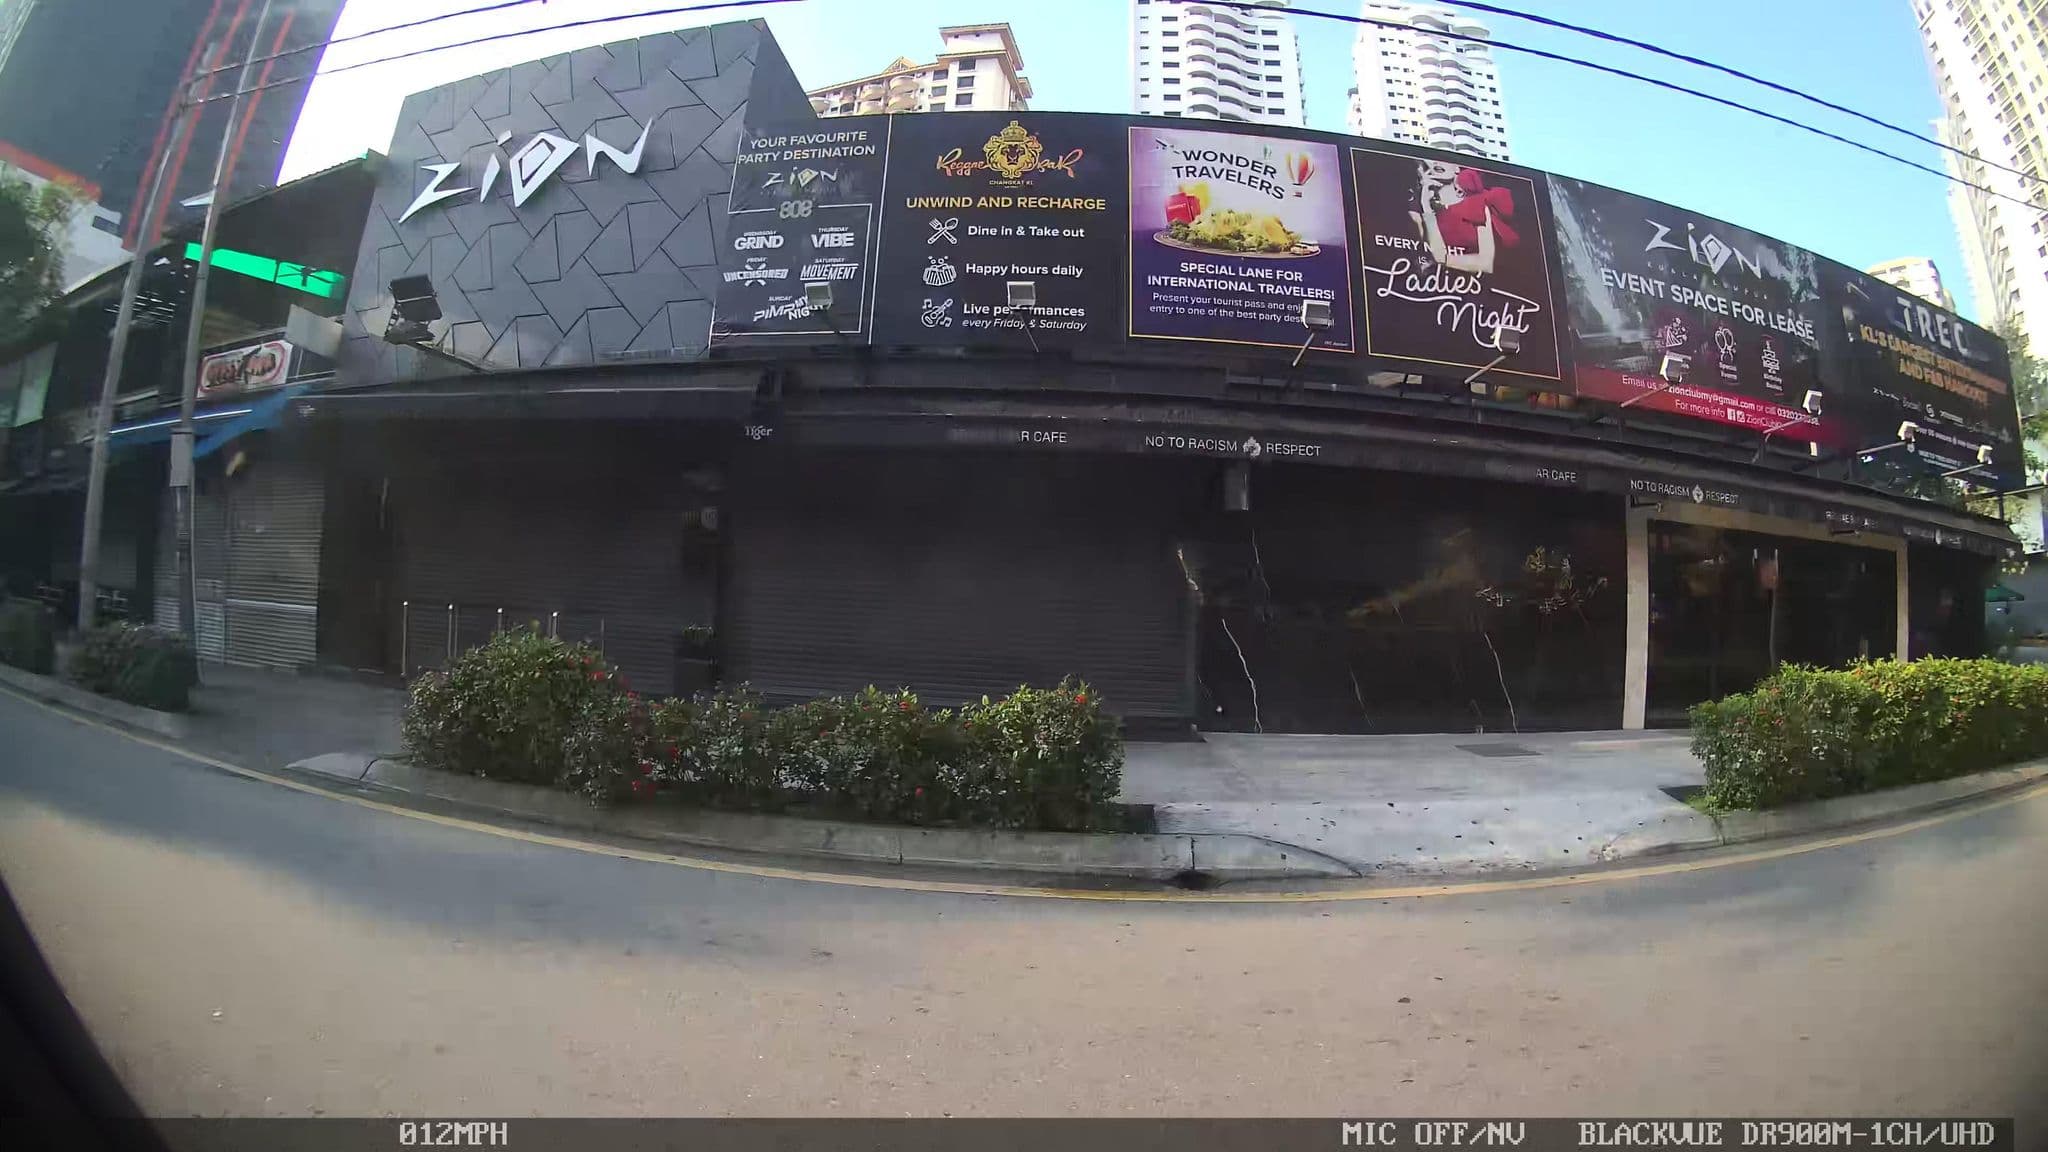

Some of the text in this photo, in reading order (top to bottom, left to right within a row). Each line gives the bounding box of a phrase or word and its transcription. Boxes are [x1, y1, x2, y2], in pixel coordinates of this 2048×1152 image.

[750, 131, 868, 150] YOUR FAVOURITE
[738, 145, 876, 164] PARTY DESTINATION
[1182, 150, 1278, 180] WONDER
[1171, 165, 1286, 200] TRAVELERS
[779, 200, 813, 219] 808
[906, 197, 1106, 210] UNWIND AND RECHARGE
[811, 232, 855, 248] VIBE
[967, 226, 1086, 238] Dine in & Take out
[734, 235, 785, 250] GRIND
[1375, 234, 1466, 257] EVERY NHT
[1418, 256, 1427, 265] IS
[800, 264, 859, 281] MOVEMENT
[965, 263, 1084, 278] Happy hours daily
[1180, 262, 1304, 283] SPECIAL LANE FOR
[1147, 275, 1336, 301] INTERNATIONAL TRAVELERS!
[963, 303, 1085, 317] Live pemances
[1152, 292, 1305, 314] Present your tourist pass and enj
[1600, 267, 1816, 342] EVENT SPACE FOR LEASE
[1149, 305, 1174, 315] entry
[1175, 306, 1186, 314] to
[1187, 307, 1206, 316] one
[1207, 307, 1218, 316] of
[1219, 308, 1235, 318] the
[1236, 310, 1257, 319] best
[1258, 313, 1282, 323] party
[962, 318, 1087, 332] every Friday & Saturday
[1437, 302, 1534, 347] Night
[1897, 296, 1969, 357] TREC
[1622, 374, 1646, 388] Email
[1646, 381, 1657, 390] us
[1675, 399, 1689, 410] For
[1689, 404, 1710, 415] more
[1711, 407, 1726, 418] info
[1033, 431, 1068, 443] CAFE
[1145, 435, 1322, 457] NO TO RACISM RESPECT
[1535, 468, 1549, 480] AR
[1551, 469, 1577, 483] CAFE
[1630, 479, 1739, 505] NO TO RACISM RESPECT
